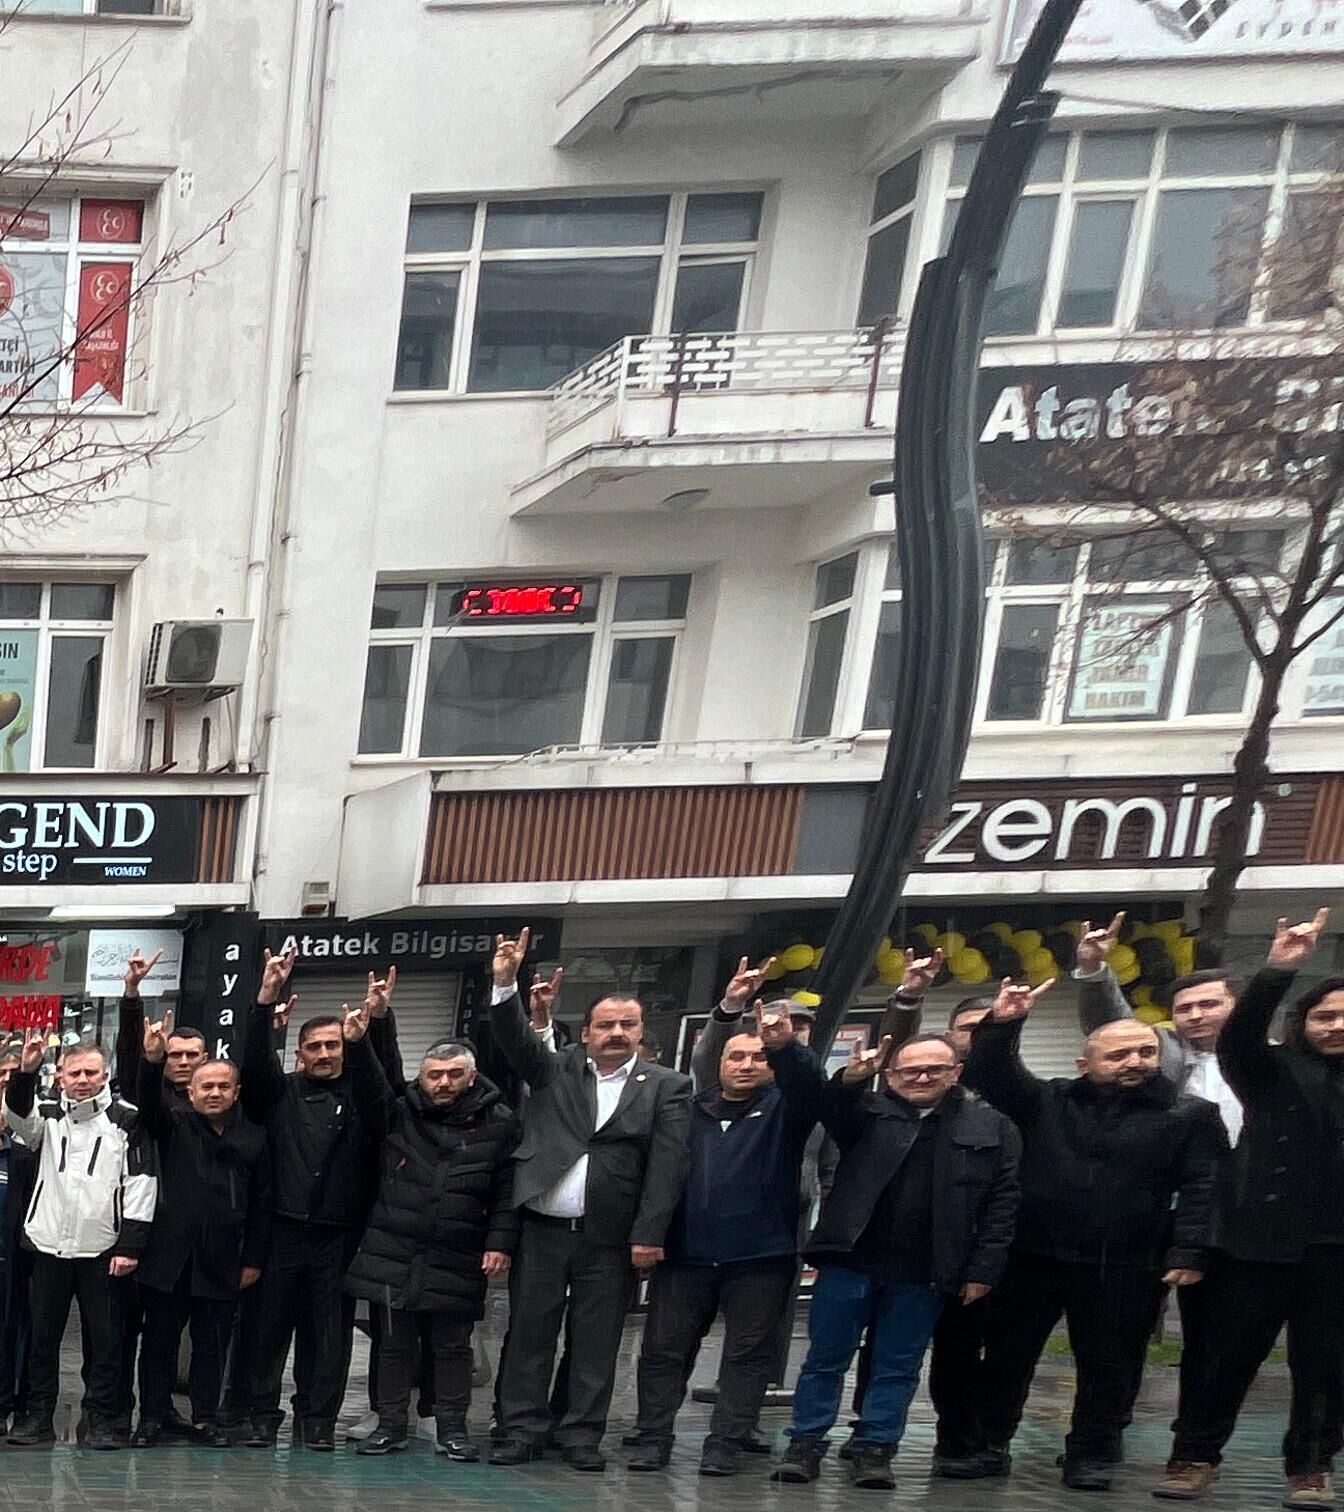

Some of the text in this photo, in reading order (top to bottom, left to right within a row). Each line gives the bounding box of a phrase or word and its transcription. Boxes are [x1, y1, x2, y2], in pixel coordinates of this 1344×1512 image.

[979, 382, 1174, 443] Atate
[923, 783, 1267, 864] zemin
[3, 849, 58, 881] step
[104, 866, 147, 877] WOMEN
[279, 929, 544, 960] Atatek Bilgisar
